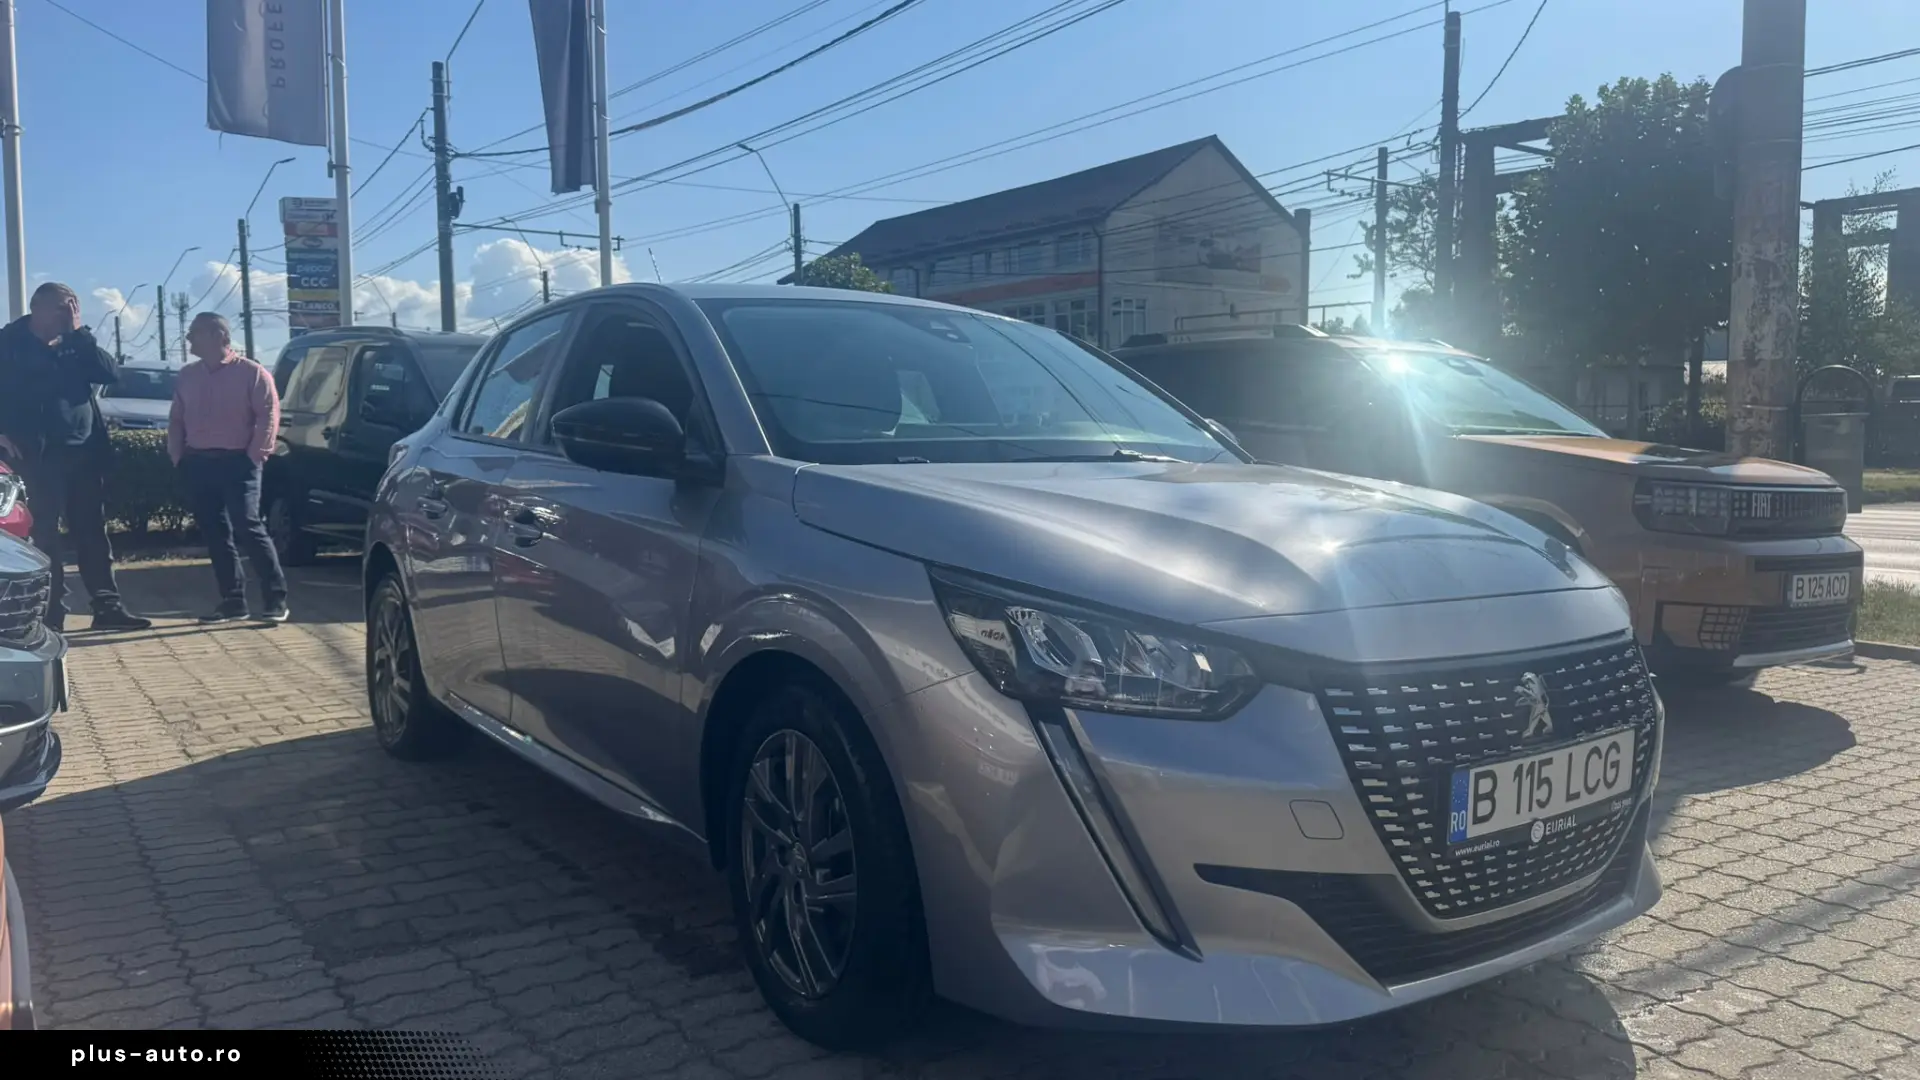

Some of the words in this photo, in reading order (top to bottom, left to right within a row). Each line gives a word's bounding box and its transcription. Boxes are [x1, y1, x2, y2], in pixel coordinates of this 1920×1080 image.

[301, 277, 328, 286] CCC
[1751, 492, 1771, 518] FIAT
[1795, 577, 1804, 600] B
[1808, 575, 1824, 598] 125
[1472, 769, 1498, 825] B
[1513, 757, 1553, 815] 115
[1565, 741, 1620, 802] LCG
[1450, 810, 1467, 834] RO
[1545, 814, 1577, 835] EURIAL
[1455, 840, 1501, 856] www.eurial.ro
